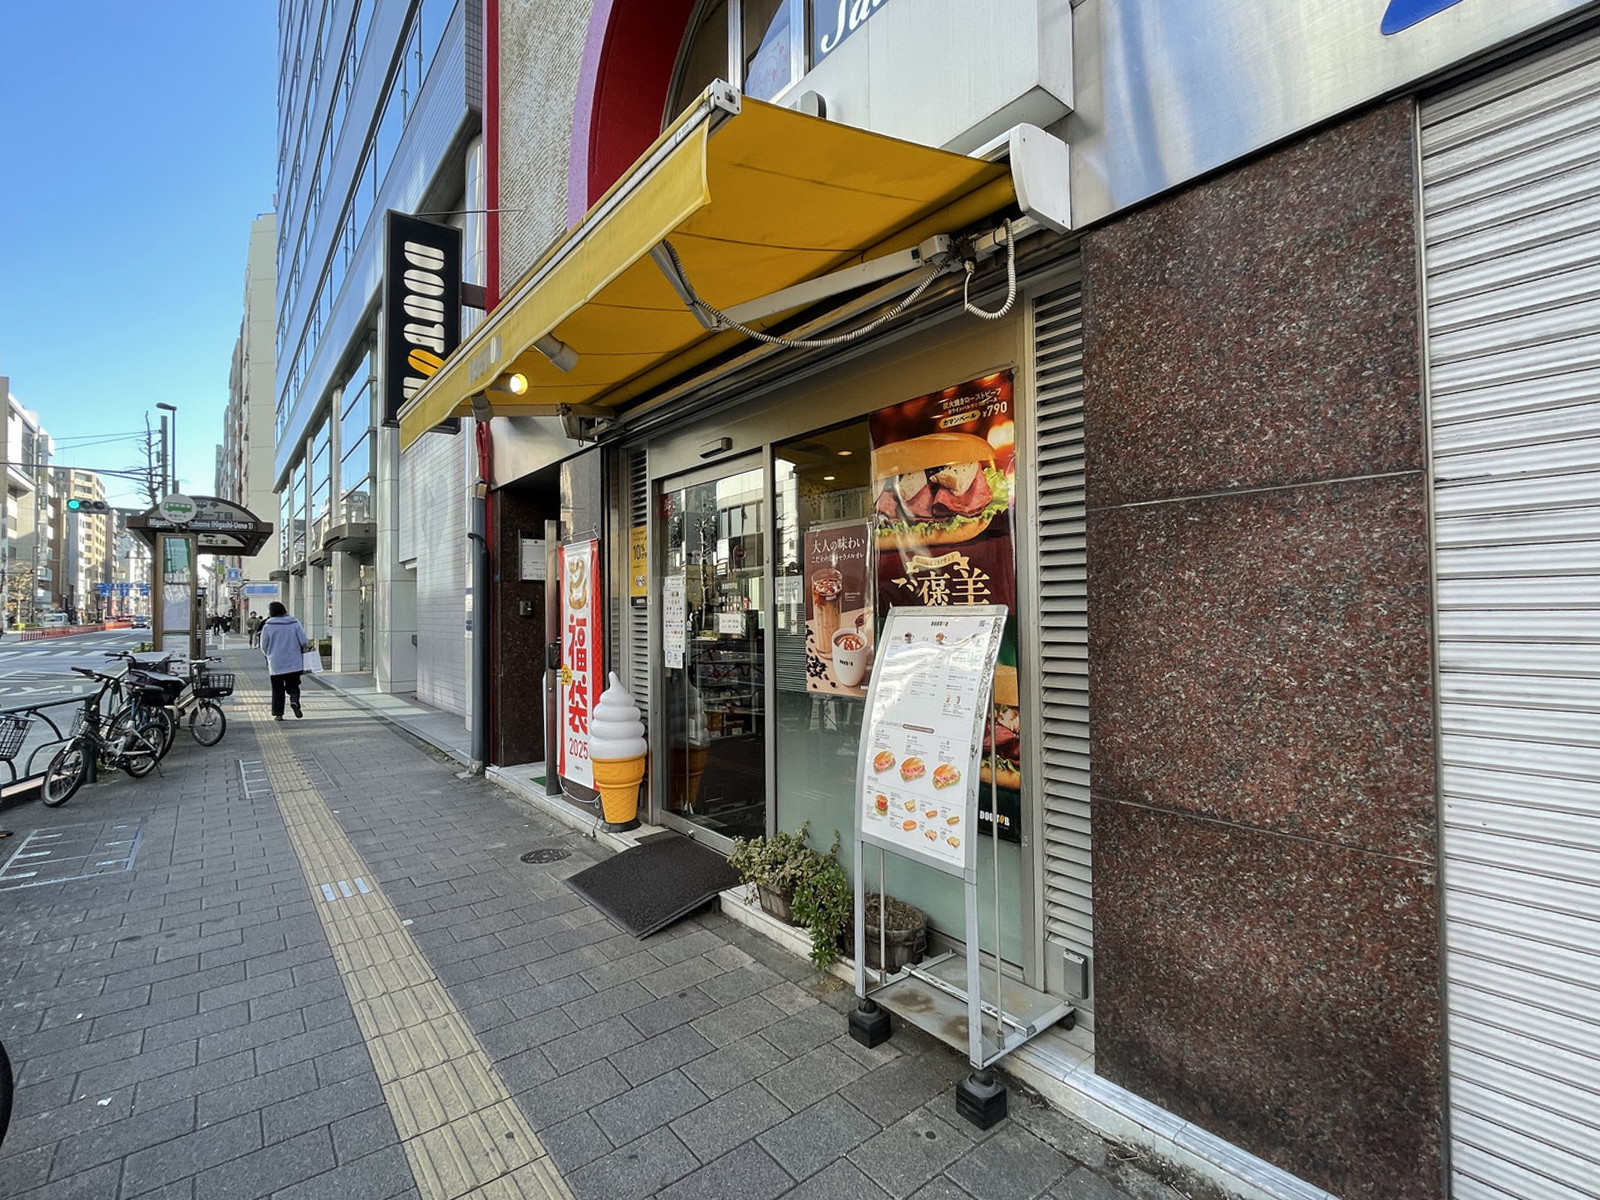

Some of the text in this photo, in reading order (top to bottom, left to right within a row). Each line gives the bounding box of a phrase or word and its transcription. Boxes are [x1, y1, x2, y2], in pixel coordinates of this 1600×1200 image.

[982, 401, 1008, 418] ¥790
[943, 413, 977, 426] カマンベール
[812, 537, 865, 554] 大人の味わい
[568, 614, 588, 735] 福袋
[569, 737, 589, 761] 2025
